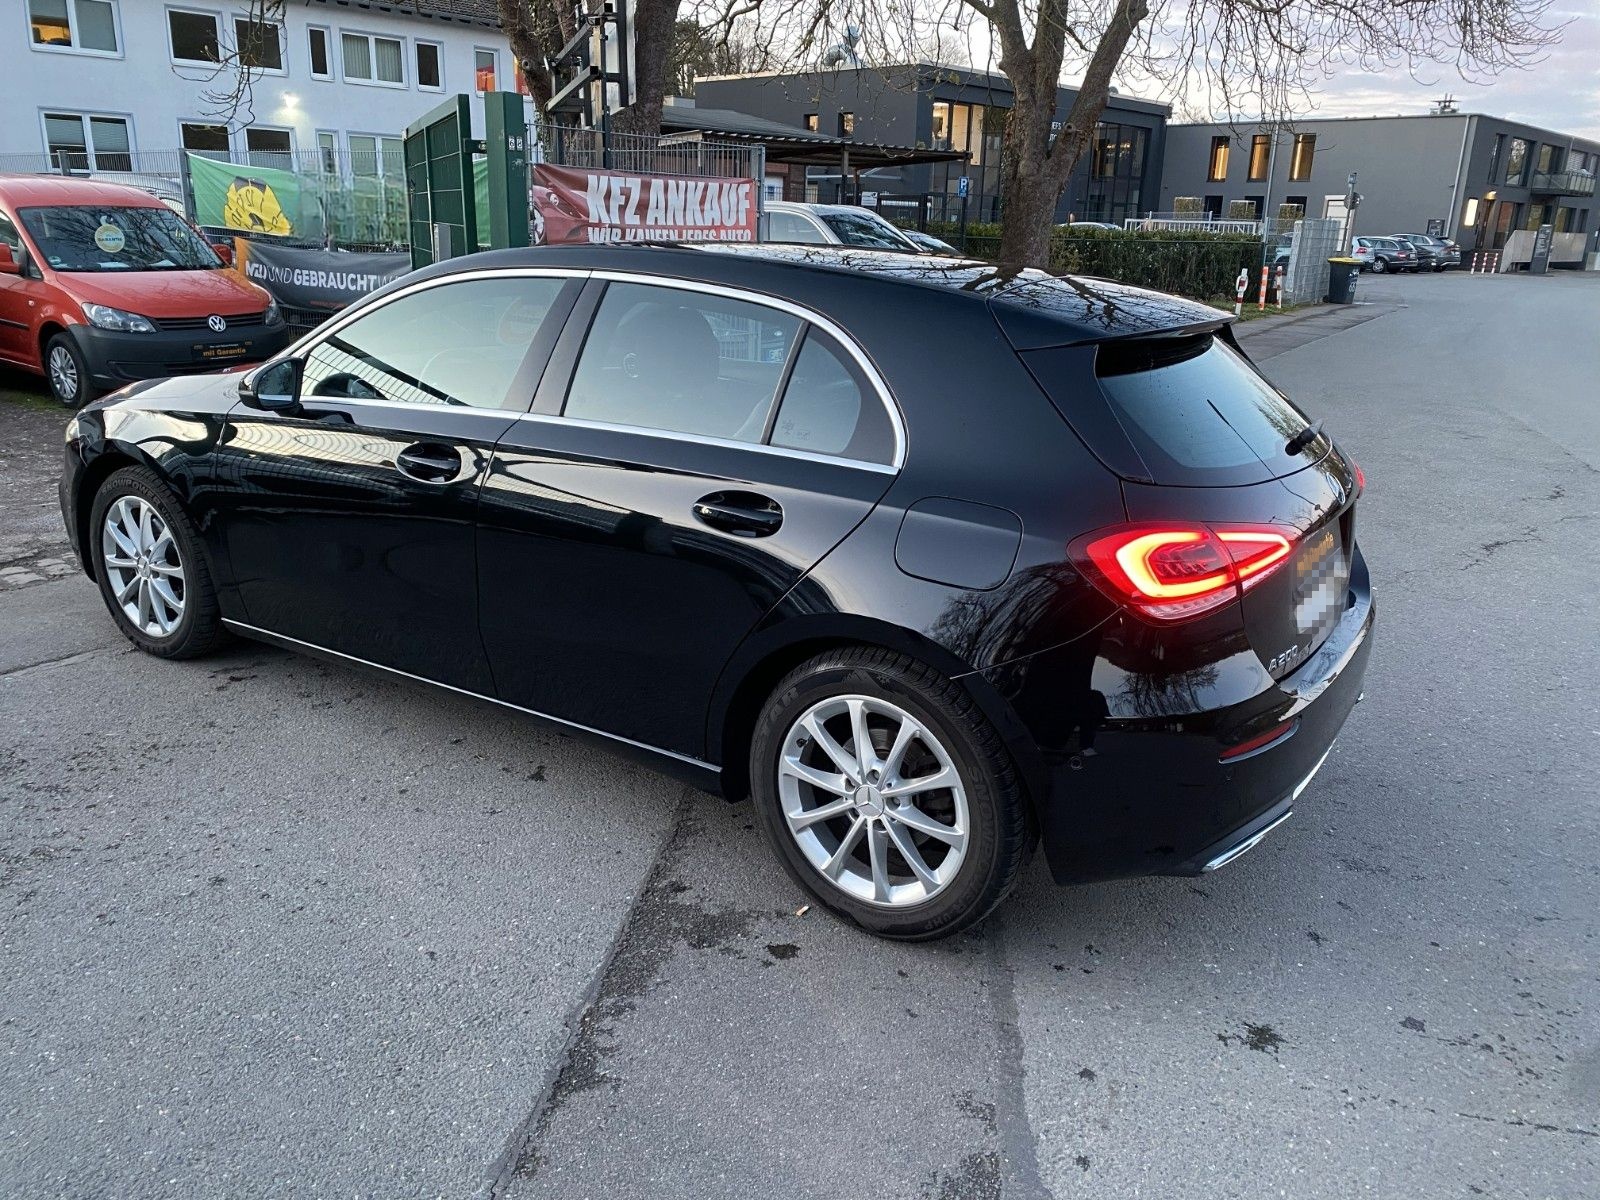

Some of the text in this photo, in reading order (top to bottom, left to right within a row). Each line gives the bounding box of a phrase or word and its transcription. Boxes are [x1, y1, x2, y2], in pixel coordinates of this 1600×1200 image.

[960, 178, 968, 190] P
[587, 174, 750, 227] KFZ ANKAUF
[588, 226, 621, 242] WIR
[216, 347, 247, 356] Garantie
